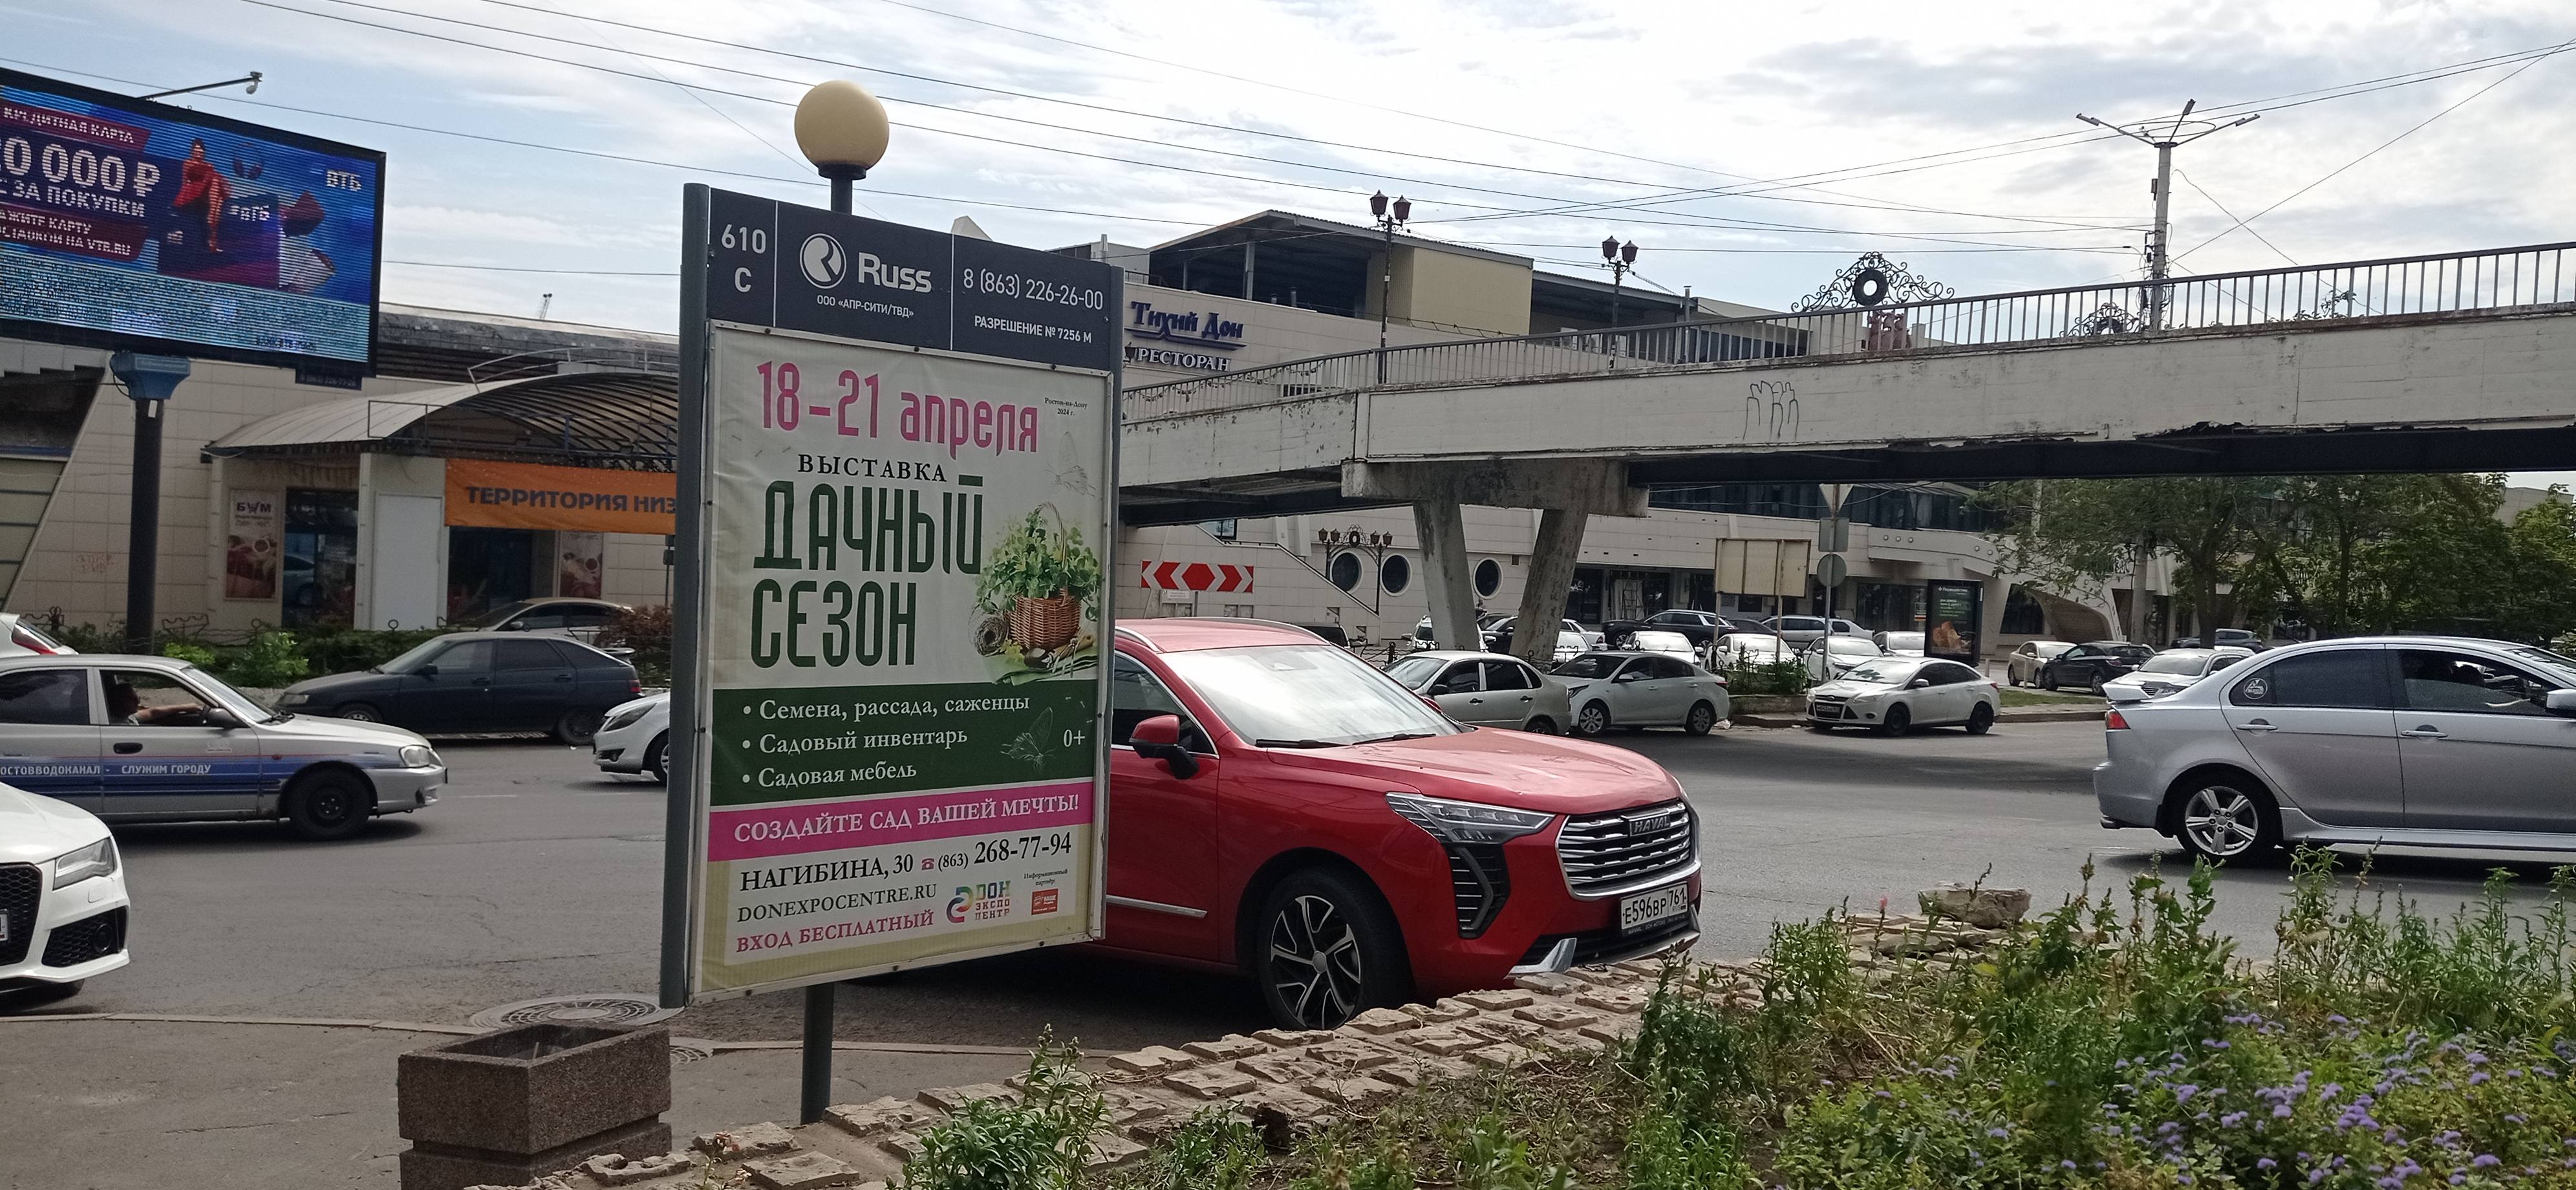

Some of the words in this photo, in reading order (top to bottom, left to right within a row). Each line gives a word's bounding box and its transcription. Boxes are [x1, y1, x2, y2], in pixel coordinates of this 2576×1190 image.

[91, 124, 134, 143] КАРТА
[0, 136, 32, 176] 0
[42, 144, 126, 192] 000
[327, 170, 361, 191] ВТБ
[13, 180, 41, 200] ЗА
[47, 186, 145, 217] ПОКУПКИ
[49, 217, 91, 234] КАРТУ
[721, 224, 766, 254] 610
[735, 268, 751, 293] С
[858, 252, 932, 293] Russ
[963, 269, 973, 288] 8
[980, 270, 1020, 299] (863)
[1026, 279, 1103, 310] 226-26-00
[817, 295, 835, 307] ООО
[838, 299, 914, 318] «АПР-СИТИ/ТВД»
[974, 316, 1042, 336] РАЗРЕШЕНИЕ
[1045, 324, 1055, 337] №
[1058, 327, 1080, 341] 7256
[1082, 332, 1091, 343] М
[1131, 301, 1199, 334] Тихий
[1201, 312, 1244, 340] Дон
[1137, 347, 1232, 372] РЕСТОРАН
[1044, 397, 1088, 409] Ростов-на-Дону
[900, 391, 1037, 460] апреля
[798, 454, 947, 482] ВЫСТАВКА
[467, 486, 628, 512] ТЕРРИТОРИЯ
[753, 475, 983, 574] ДАЧНЫЙ
[751, 579, 916, 667] СЕЗОН
[759, 700, 848, 722] Семена,
[855, 699, 938, 722] рассада,
[945, 696, 1029, 715] саженцы
[759, 731, 857, 755] Садовый
[863, 730, 967, 750] инвентарь
[1063, 730, 1086, 747] 0+
[0, 764, 100, 776] ОСТОВВОДОКАНАЛ
[122, 764, 168, 775] СЛУЖИМ
[171, 764, 211, 775] ГОРОДУ
[758, 767, 844, 789] Садовая
[850, 760, 916, 783] мебель
[735, 810, 863, 841] СОЗДАЙТЕ
[870, 809, 912, 831] САД
[918, 797, 996, 825] ВАШЕЙ
[1001, 794, 1079, 817] МЕЧТЫ!
[1635, 816, 1671, 834] HAVAL
[740, 857, 889, 891] НАГИБИНА,
[892, 854, 913, 874] 30
[938, 852, 969, 872] (863)
[974, 832, 1071, 865] 268-77-94
[738, 883, 937, 922] DONEXPOCENTRE.RU
[975, 909, 1010, 921] ЦЕНТР
[736, 932, 793, 953] ВХОД
[799, 910, 934, 944] БЕСПЛАТНЫЙ
